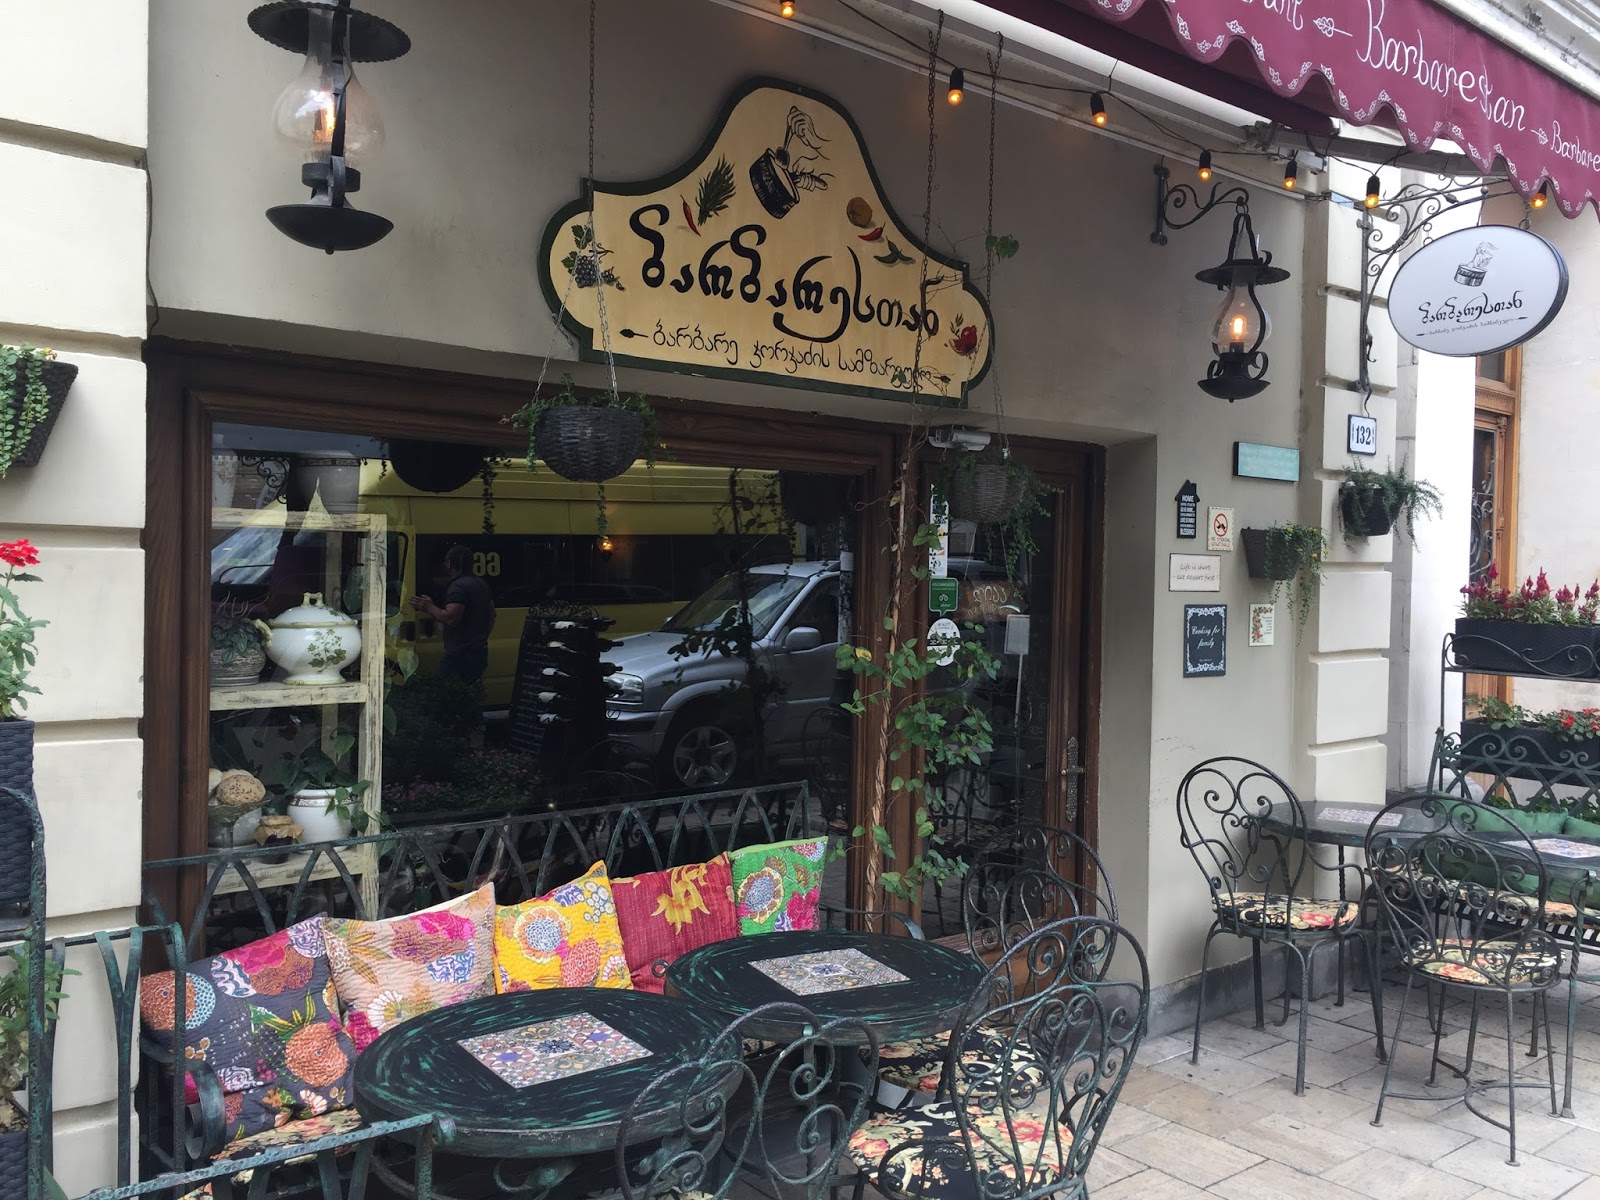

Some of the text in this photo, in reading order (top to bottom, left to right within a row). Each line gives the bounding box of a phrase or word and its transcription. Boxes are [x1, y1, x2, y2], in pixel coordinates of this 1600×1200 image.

[1355, 0, 1526, 131] Barbarestan
[652, 318, 739, 366] ბარბარე
[1355, 425, 1372, 446] 132
[1181, 494, 1195, 502] HOME
[1180, 562, 1191, 571] Life
[1197, 563, 1211, 571] short
[1191, 624, 1221, 637] Cooking for
[1197, 637, 1215, 650] family
